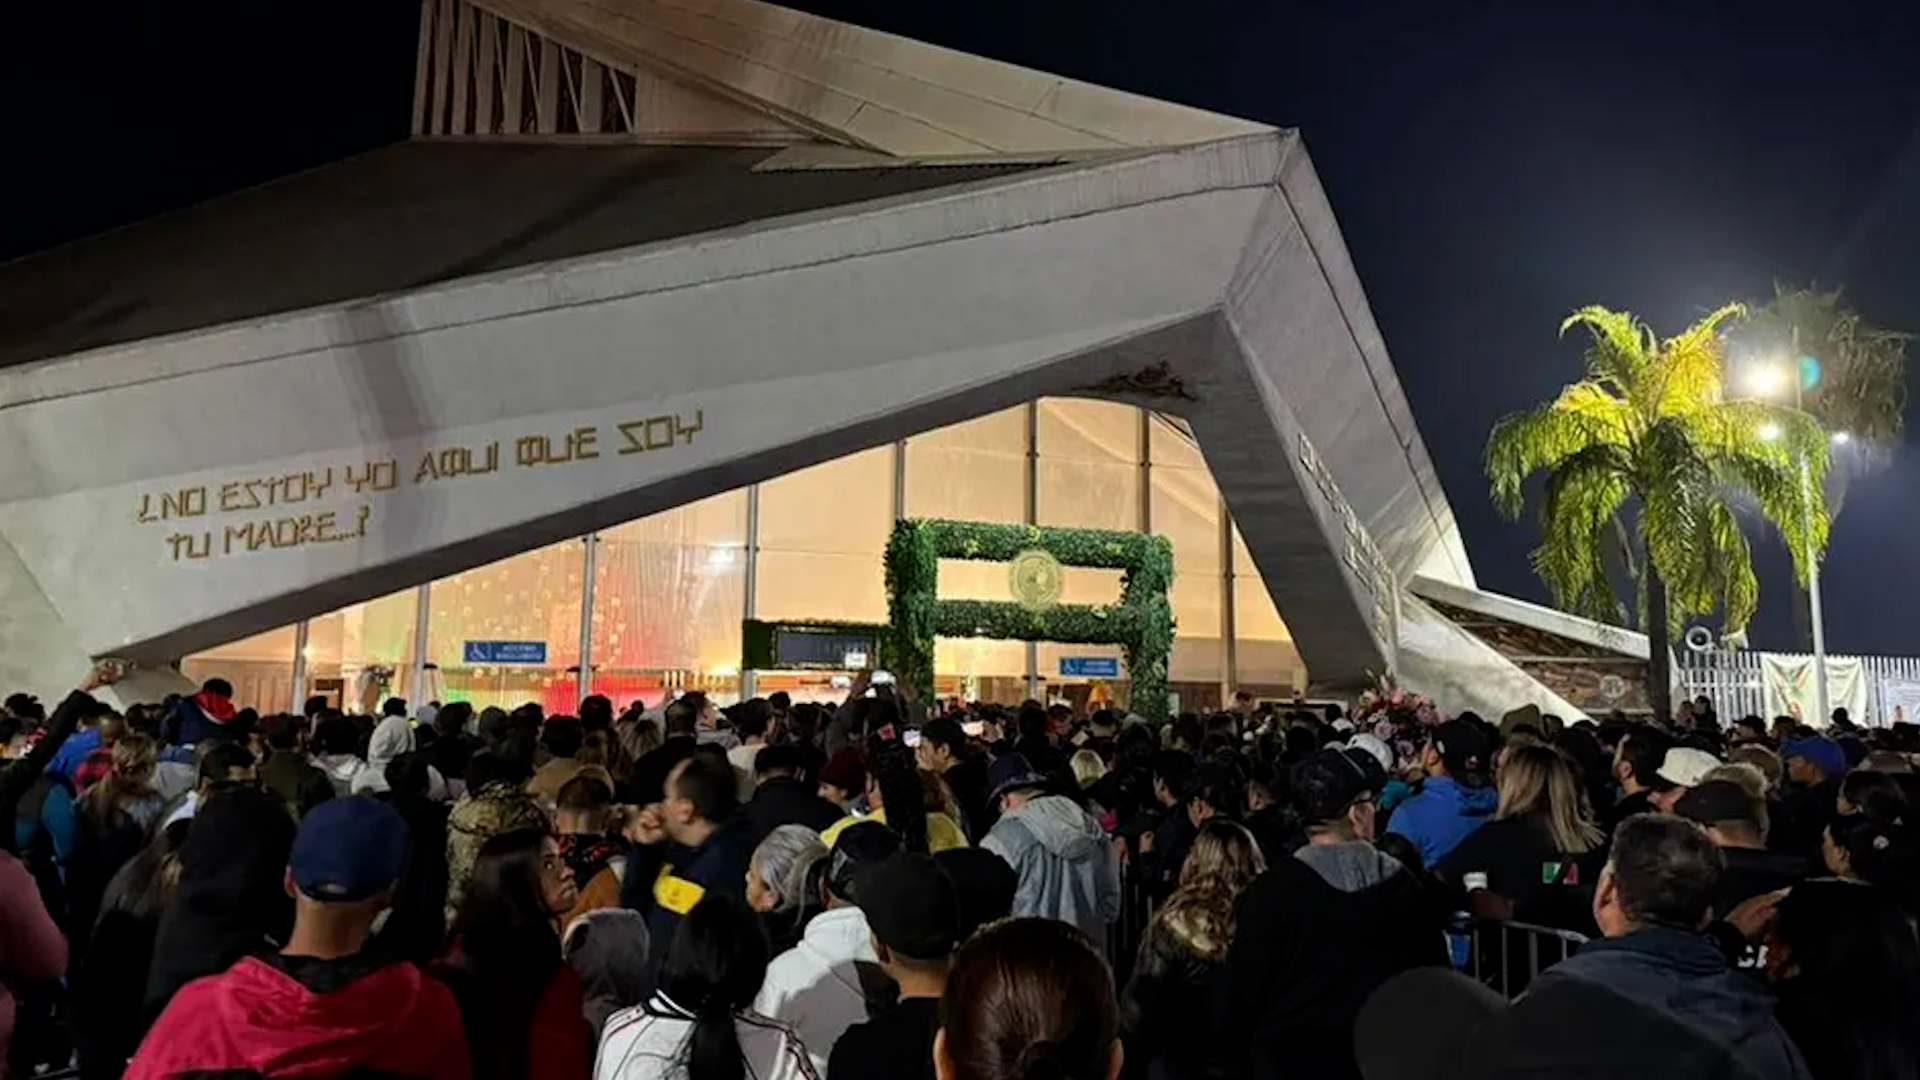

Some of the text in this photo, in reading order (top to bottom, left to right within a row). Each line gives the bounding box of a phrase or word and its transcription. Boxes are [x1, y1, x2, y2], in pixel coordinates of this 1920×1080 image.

[220, 466, 333, 512] ESTOY
[345, 460, 397, 492] YO
[515, 427, 599, 466] QUE
[617, 409, 703, 455] SOY
[165, 532, 210, 560] TU
